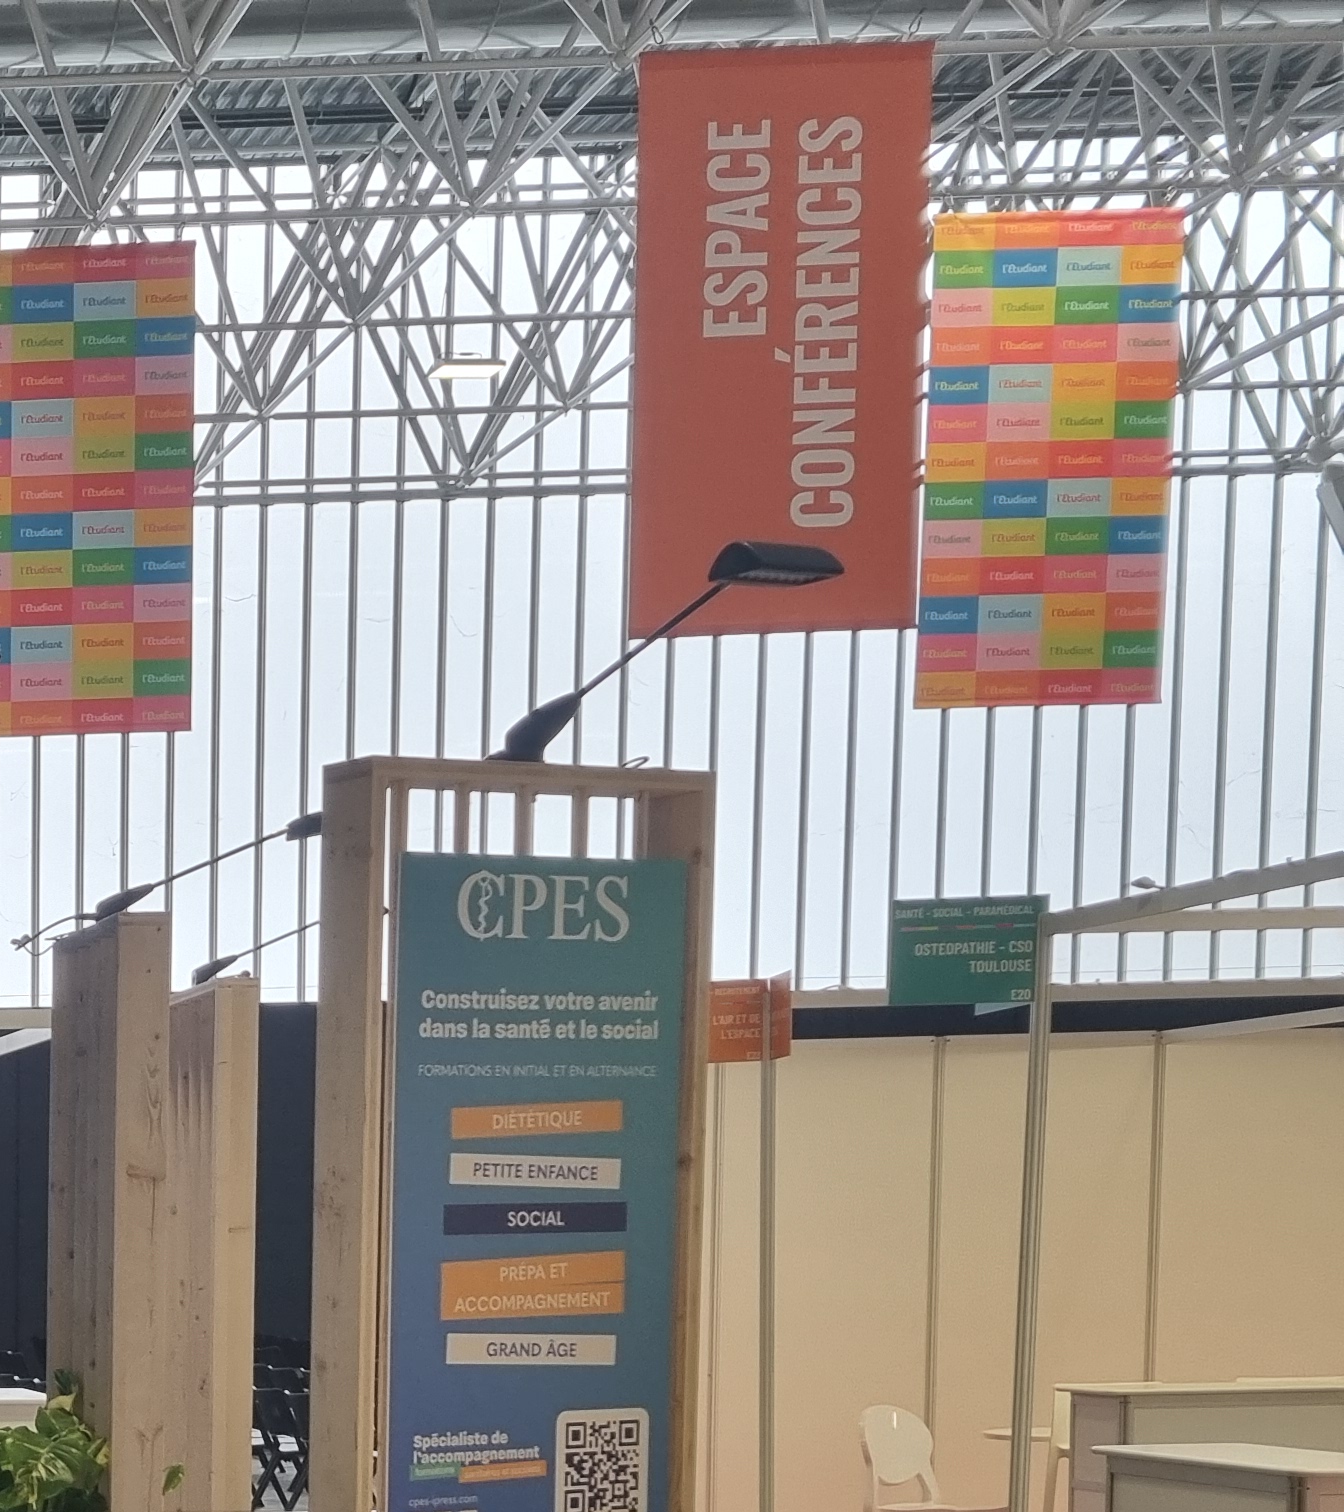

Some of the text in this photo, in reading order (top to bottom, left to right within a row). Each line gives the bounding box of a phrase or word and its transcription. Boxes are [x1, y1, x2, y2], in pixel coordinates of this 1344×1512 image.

[703, 119, 771, 338] ESPACE
[774, 116, 863, 527] CONFÉRENCES
[457, 870, 630, 941] CPES
[895, 904, 1035, 920] SANTÉ SOCIAL PARAMÉDICAL
[914, 940, 1033, 957] OSTEOPATHIE CSO
[969, 960, 1033, 974] TOULOUSE
[421, 988, 658, 1011] Construisez votre avenir
[419, 1018, 658, 1039] dans la santé et le social
[418, 1065, 656, 1077] FORMATIONS ALTERNANCE
[493, 1109, 583, 1130] DIÉTÉTIQUE
[473, 1163, 598, 1181] PETITE ENFANCE
[507, 1211, 564, 1226] SOCIAL
[499, 1263, 568, 1282] PRÉPA ET
[455, 1291, 611, 1313] ACCOMPAGNEMENT
[487, 1339, 577, 1357] GRAND ÂGE
[413, 1431, 509, 1449] Spécialiste de
[413, 1446, 540, 1466] l'accompagnement
